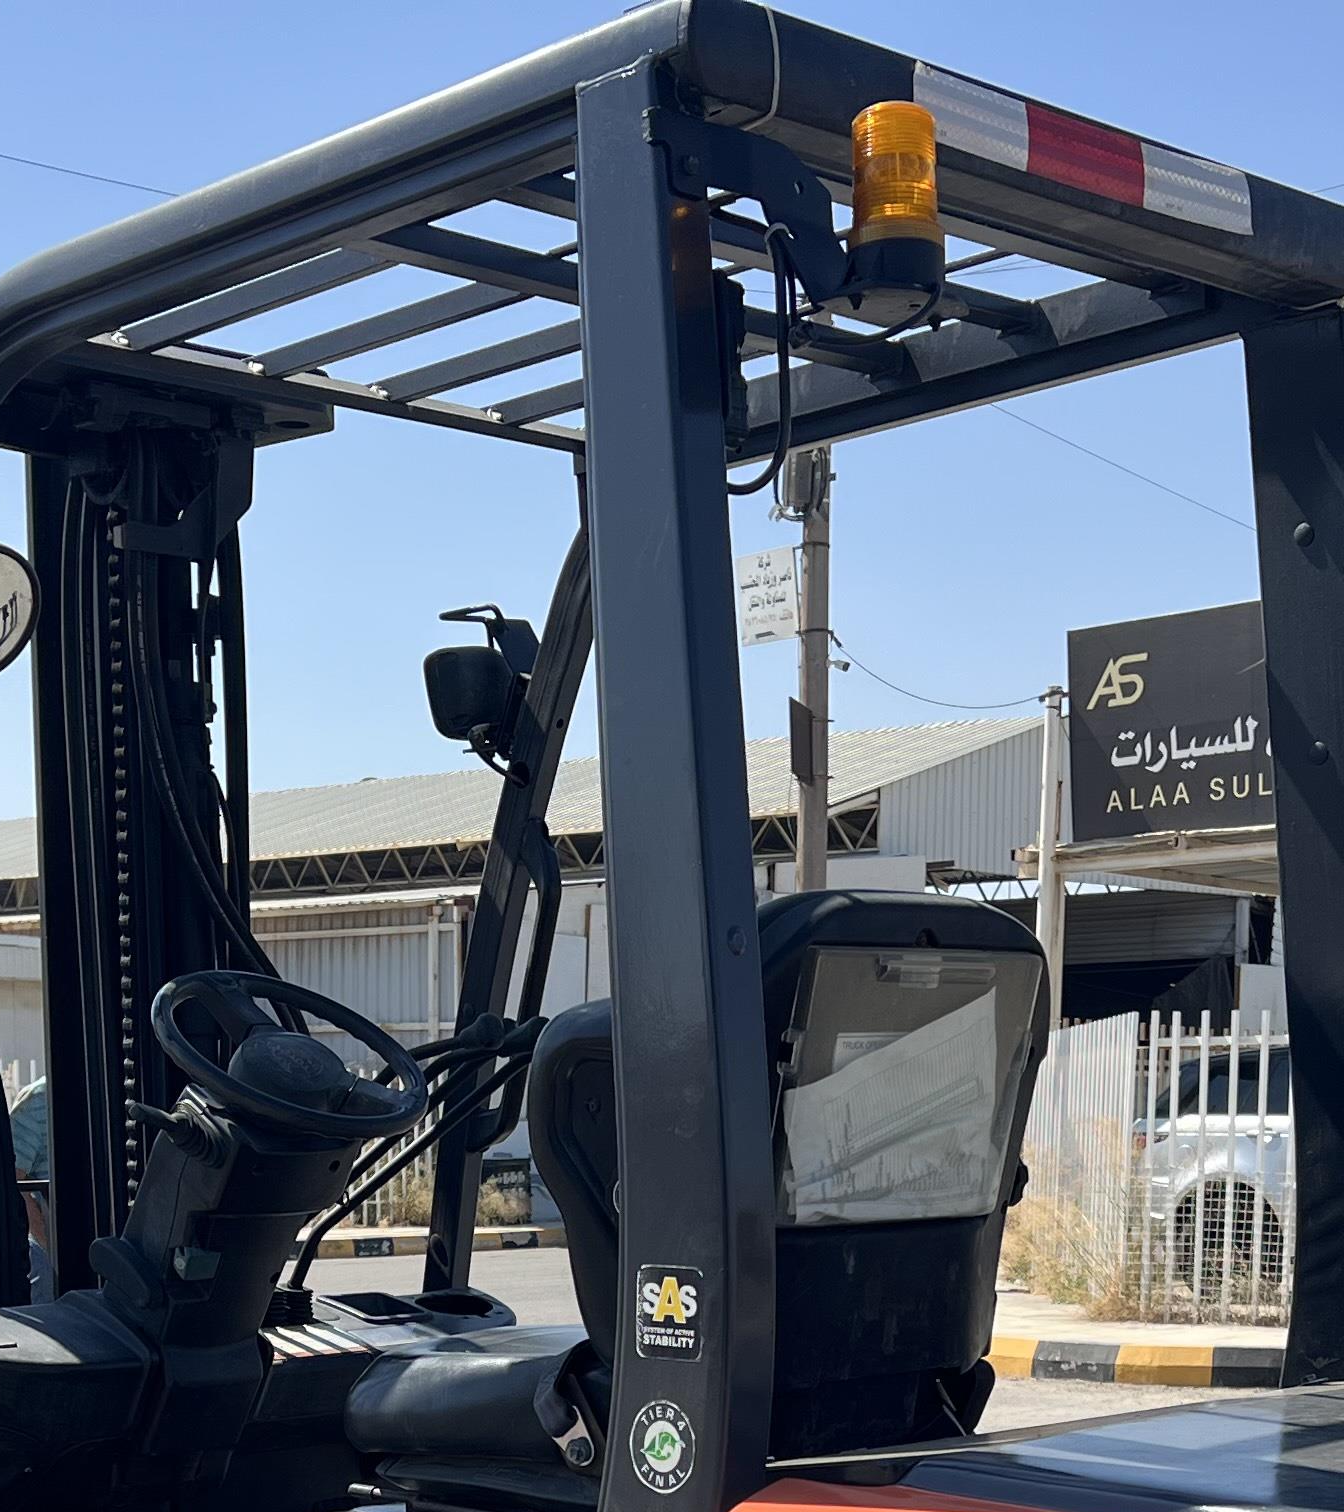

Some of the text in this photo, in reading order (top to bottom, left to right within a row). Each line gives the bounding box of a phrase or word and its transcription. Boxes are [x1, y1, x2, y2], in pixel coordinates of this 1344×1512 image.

[1087, 652, 1148, 710] AS
[1111, 715, 1259, 773] للسيارات
[1106, 781, 1191, 813] ALAA
[1209, 772, 1273, 801] SUL
[642, 1276, 698, 1325] SAS
[642, 1333, 696, 1349] STABILITY
[640, 1405, 675, 1426] TIER
[640, 1463, 686, 1487] FINAL
